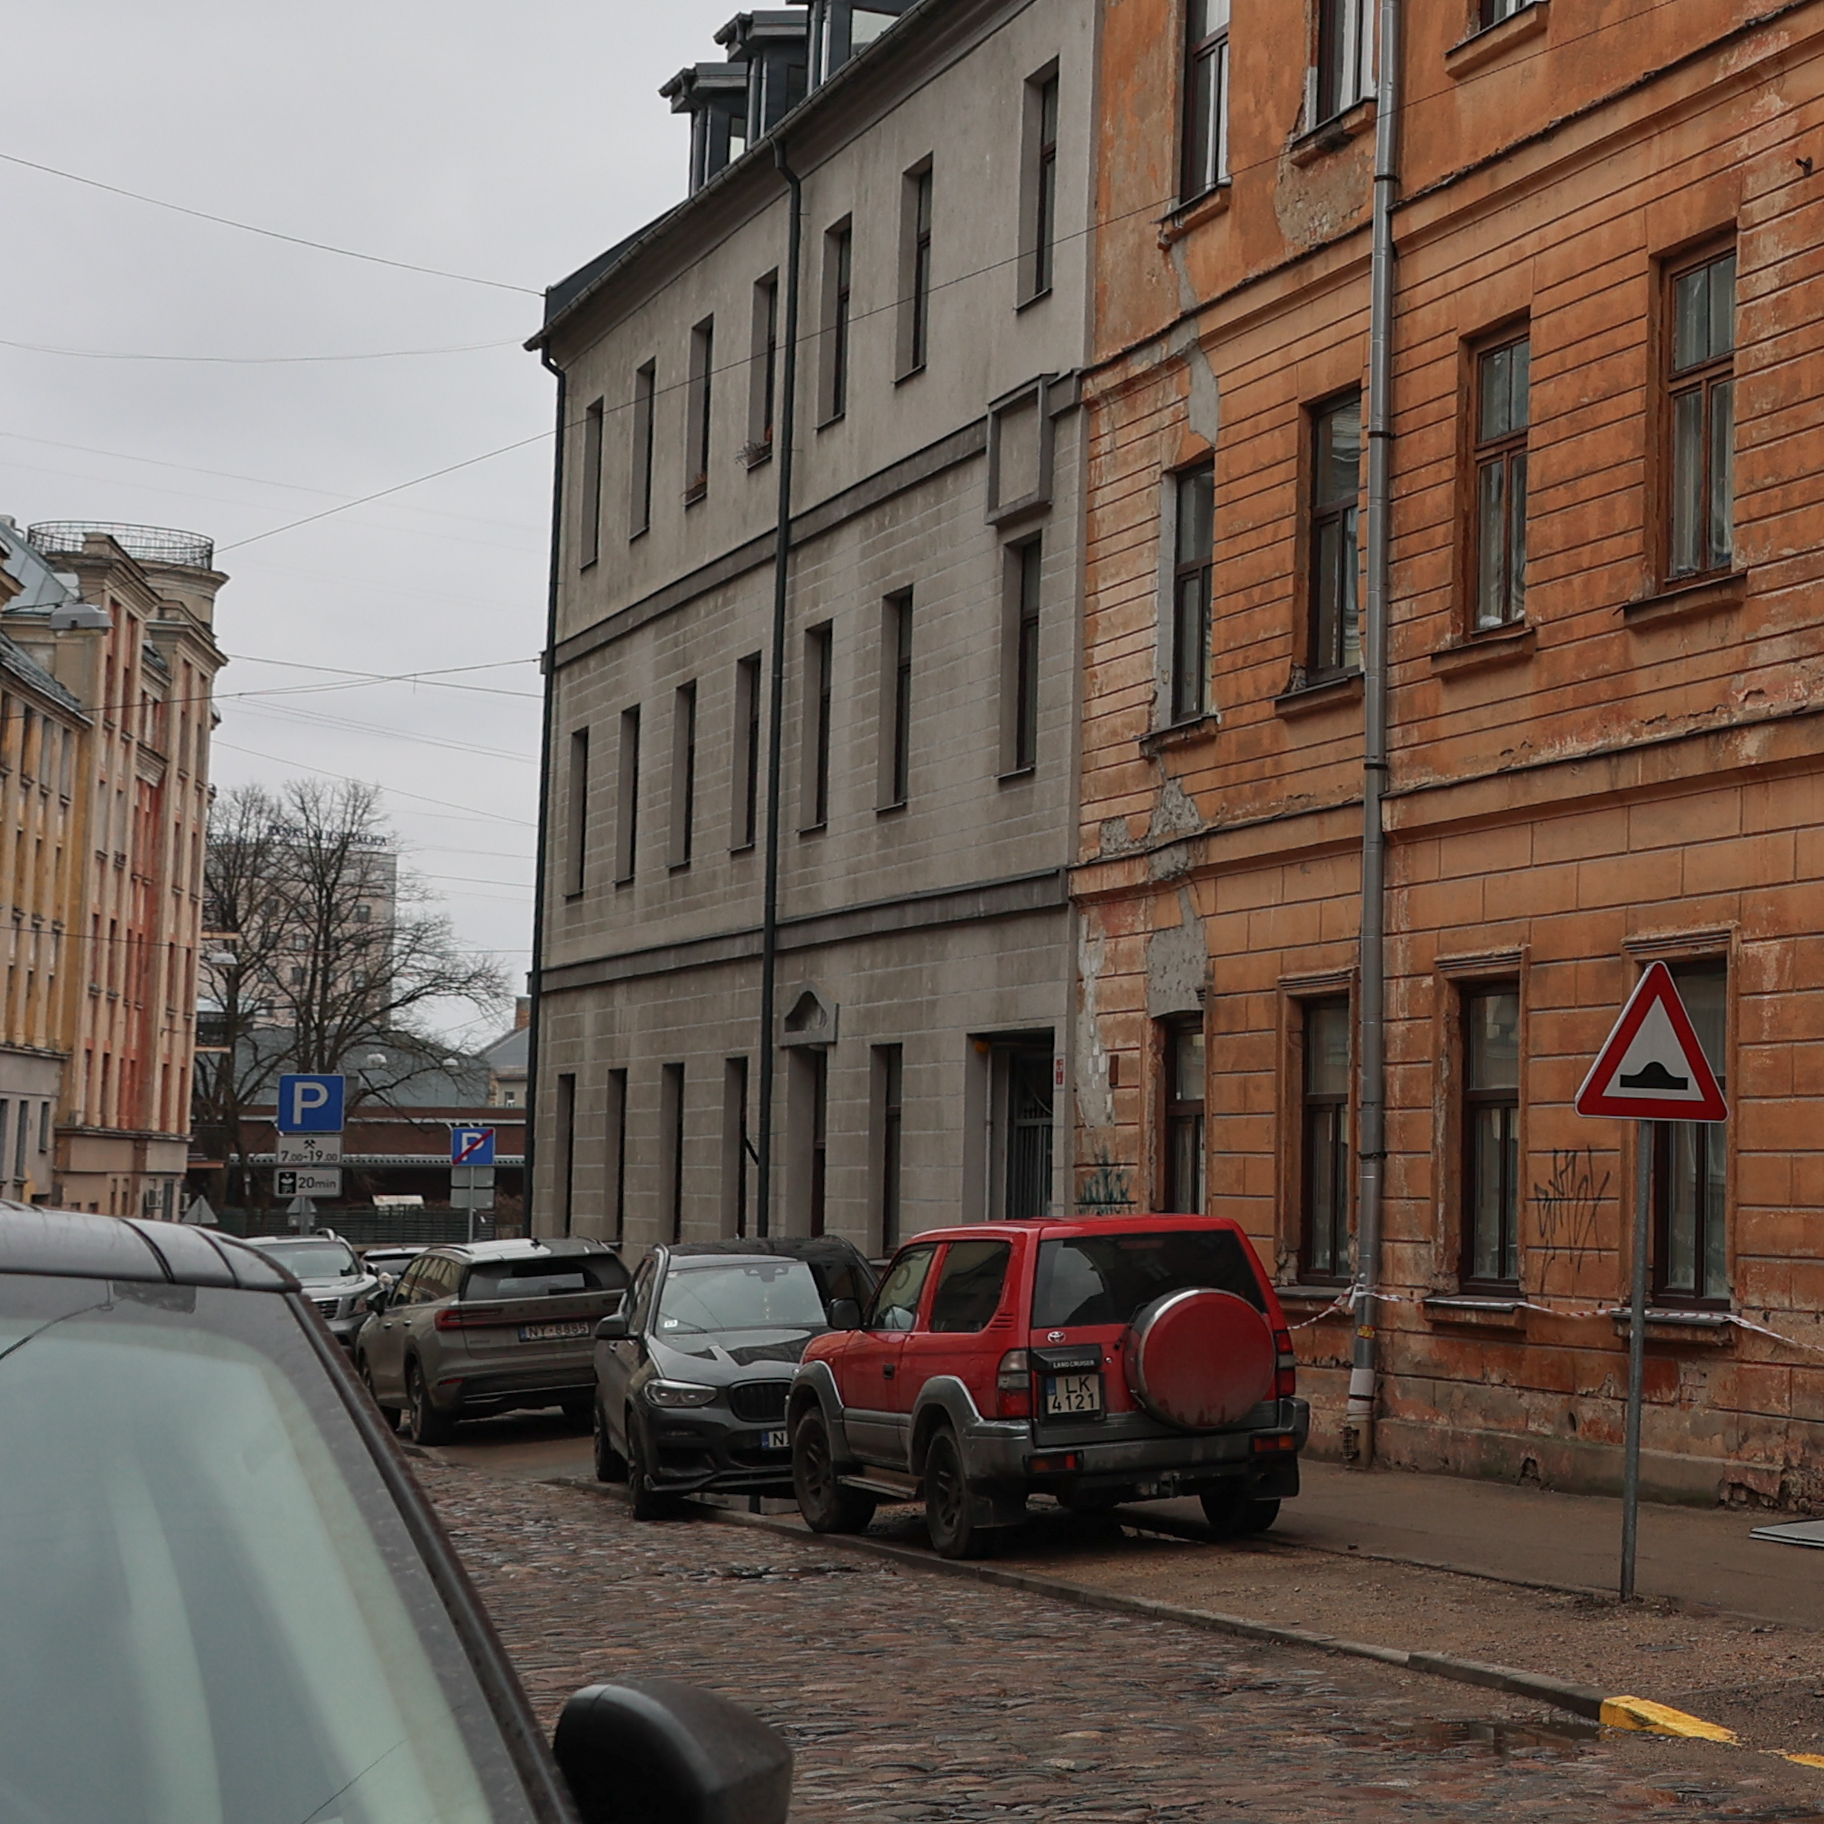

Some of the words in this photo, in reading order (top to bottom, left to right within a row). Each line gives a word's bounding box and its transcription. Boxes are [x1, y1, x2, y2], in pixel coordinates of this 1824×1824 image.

[293, 1081, 328, 1125] P
[1065, 1376, 1090, 1393] LK
[1052, 1393, 1095, 1411] 4121
